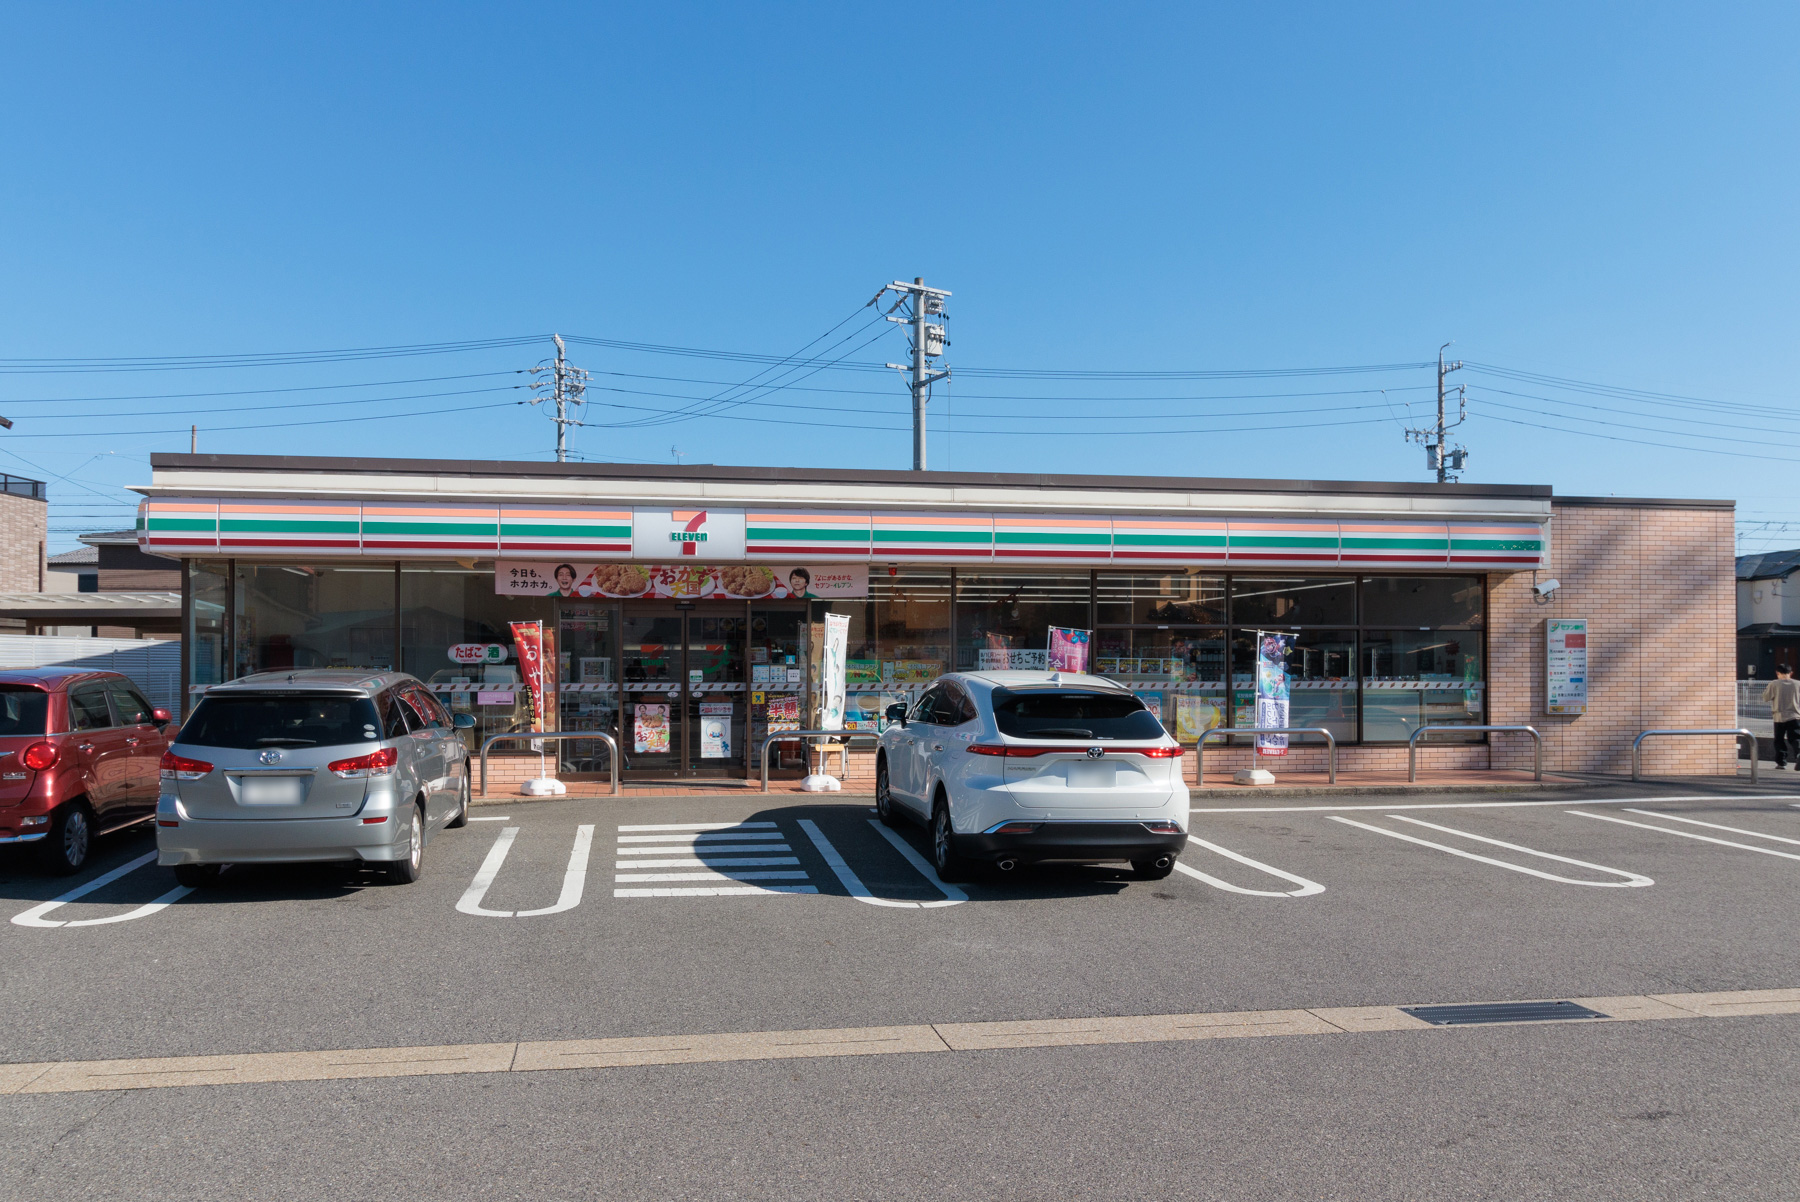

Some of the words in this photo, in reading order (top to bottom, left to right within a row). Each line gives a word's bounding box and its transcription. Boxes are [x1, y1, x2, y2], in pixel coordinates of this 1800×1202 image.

[510, 568, 542, 578] 今日も、
[660, 566, 716, 586] おかず
[510, 580, 552, 589] ホカホカ。
[669, 581, 701, 598] 天国
[455, 646, 482, 658] たばこ
[488, 646, 499, 658] 酒
[770, 701, 798, 717] 半額
[636, 729, 666, 742] おかず
[647, 739, 666, 749] 天国
